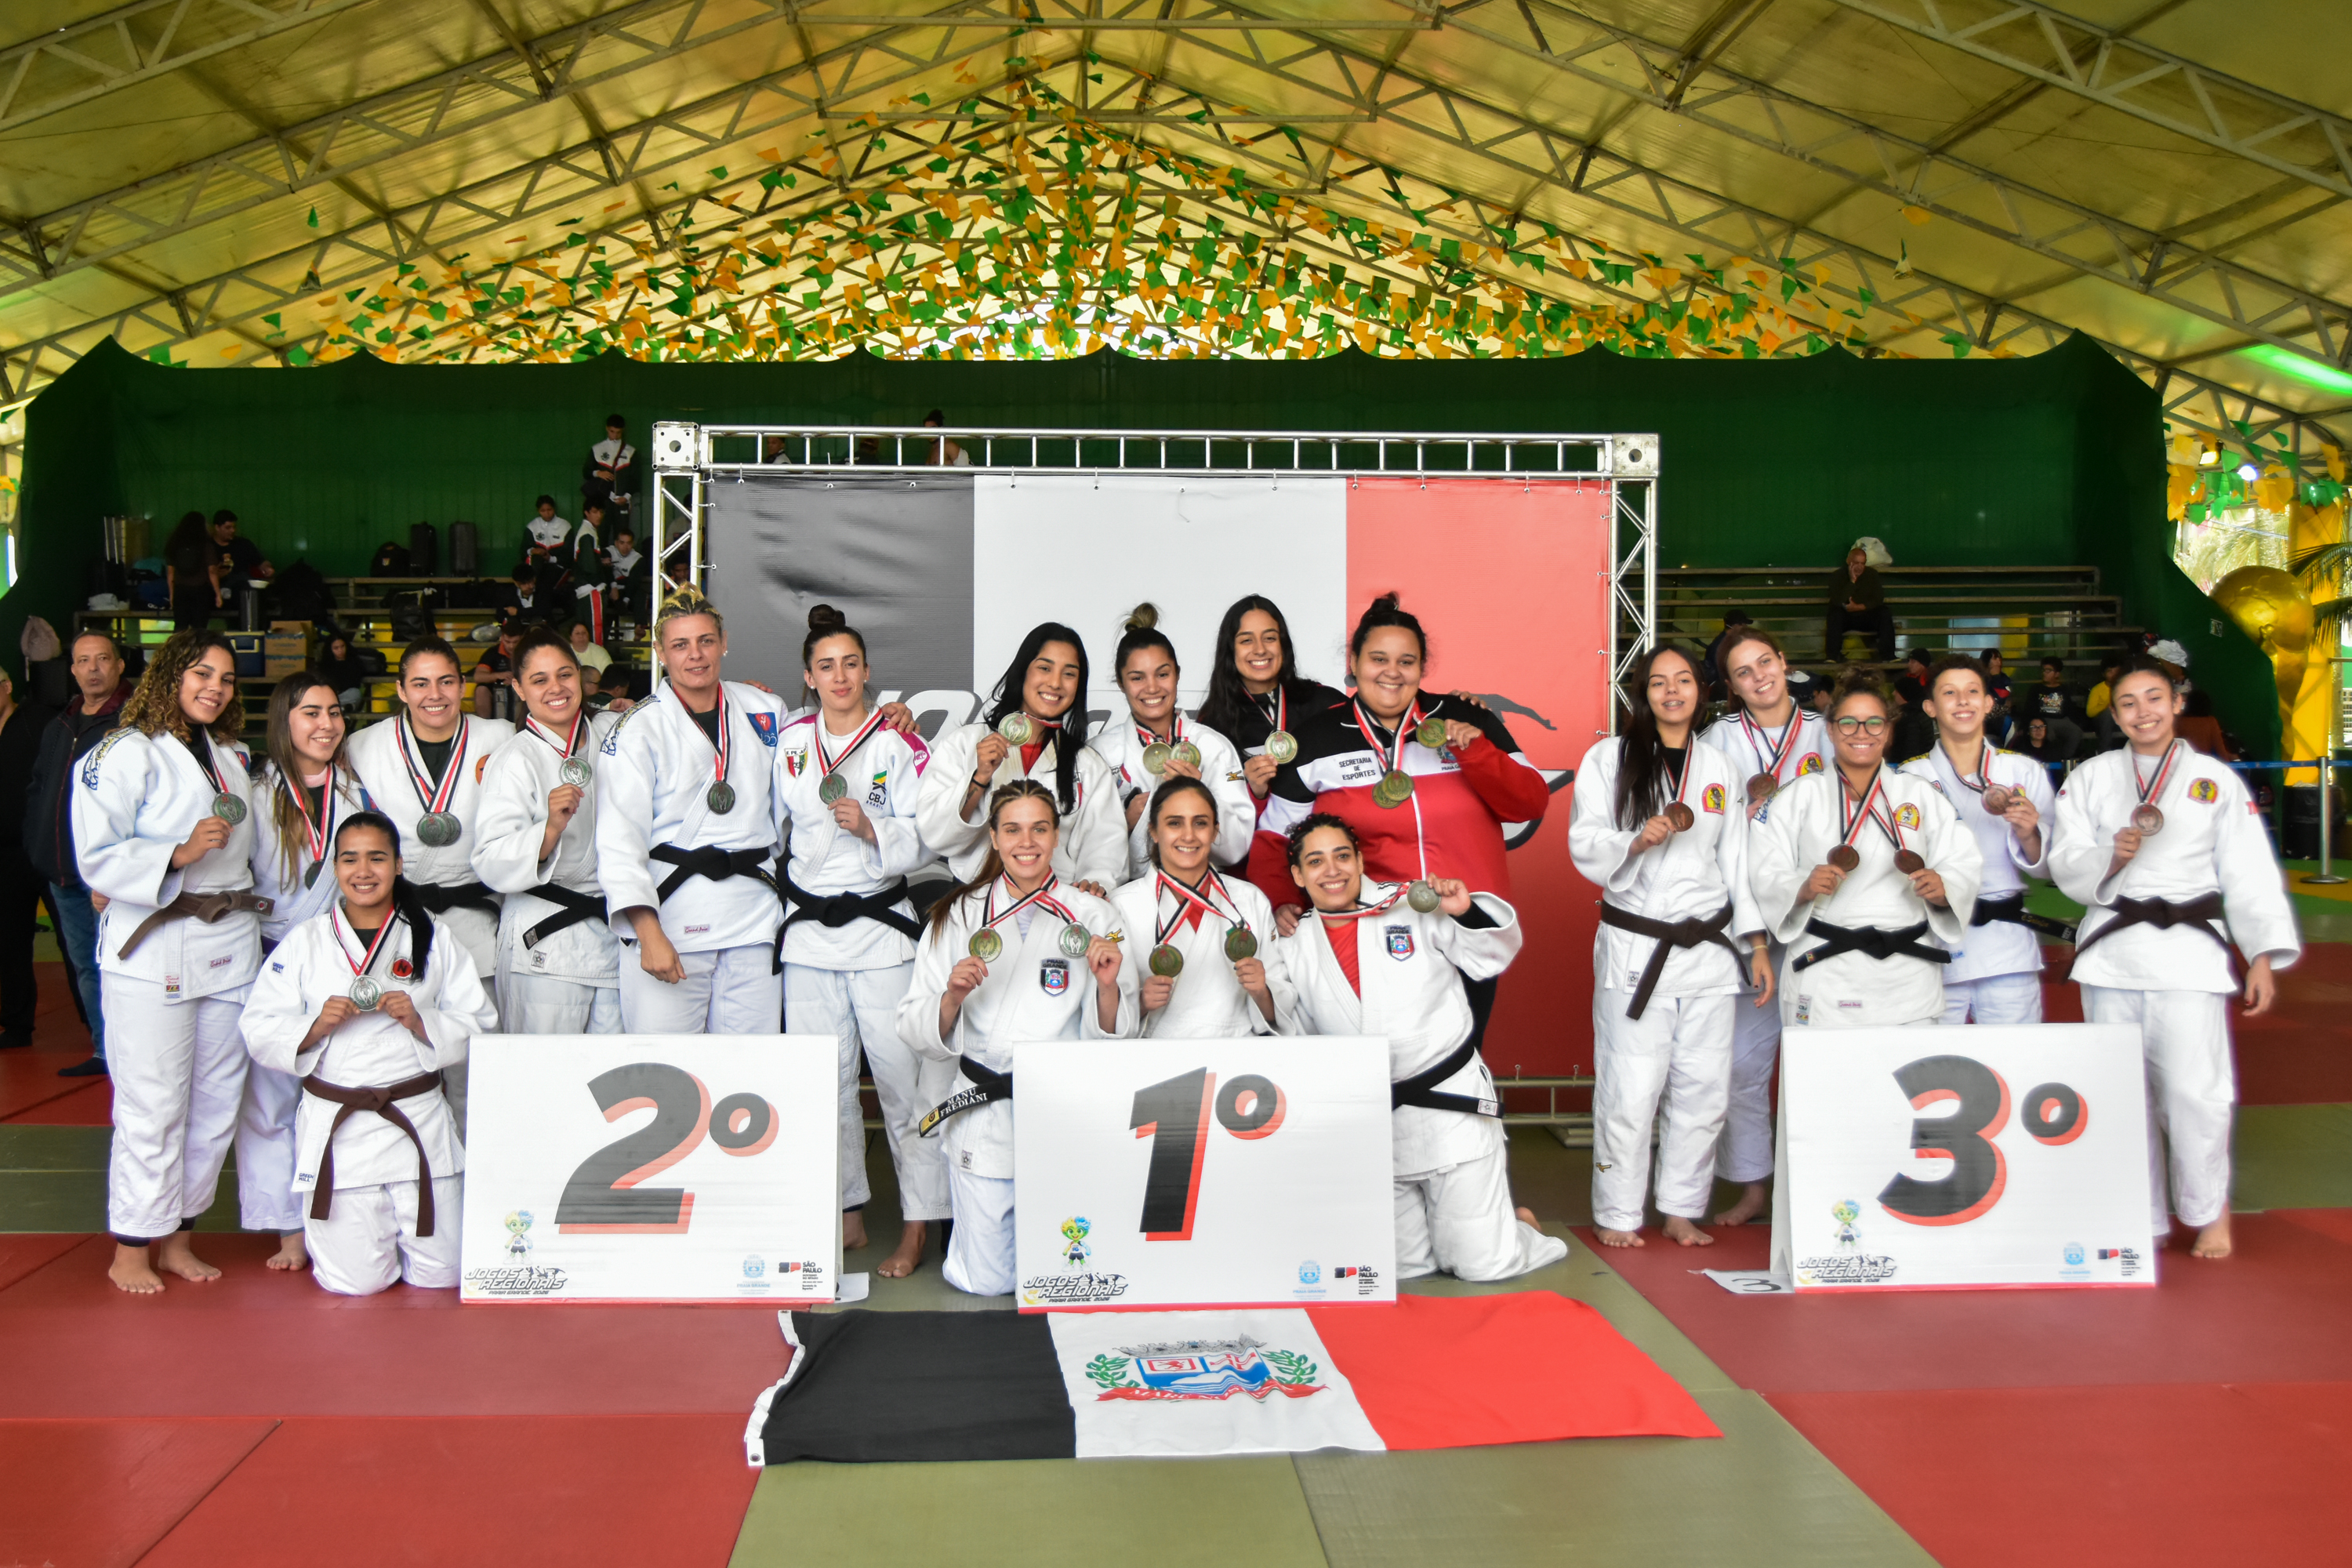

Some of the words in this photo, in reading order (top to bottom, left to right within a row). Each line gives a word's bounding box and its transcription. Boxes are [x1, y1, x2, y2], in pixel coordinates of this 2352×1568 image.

[1338, 757, 1372, 768] SECRETARIA
[1342, 769, 1376, 781] ESPORTES
[868, 792, 887, 805] CBJ
[866, 800, 884, 810] BRASIL
[947, 1087, 976, 1106] MANU
[940, 1092, 988, 1117] FREDIANI
[1797, 1257, 1854, 1269] JOGOS
[464, 1268, 524, 1280] JOGOS
[1811, 1265, 1897, 1278] REGIONAIS
[478, 1278, 568, 1290] REGIONAIS
[1023, 1275, 1083, 1289] JOGOS
[1038, 1283, 1129, 1298] REGIONAIS
